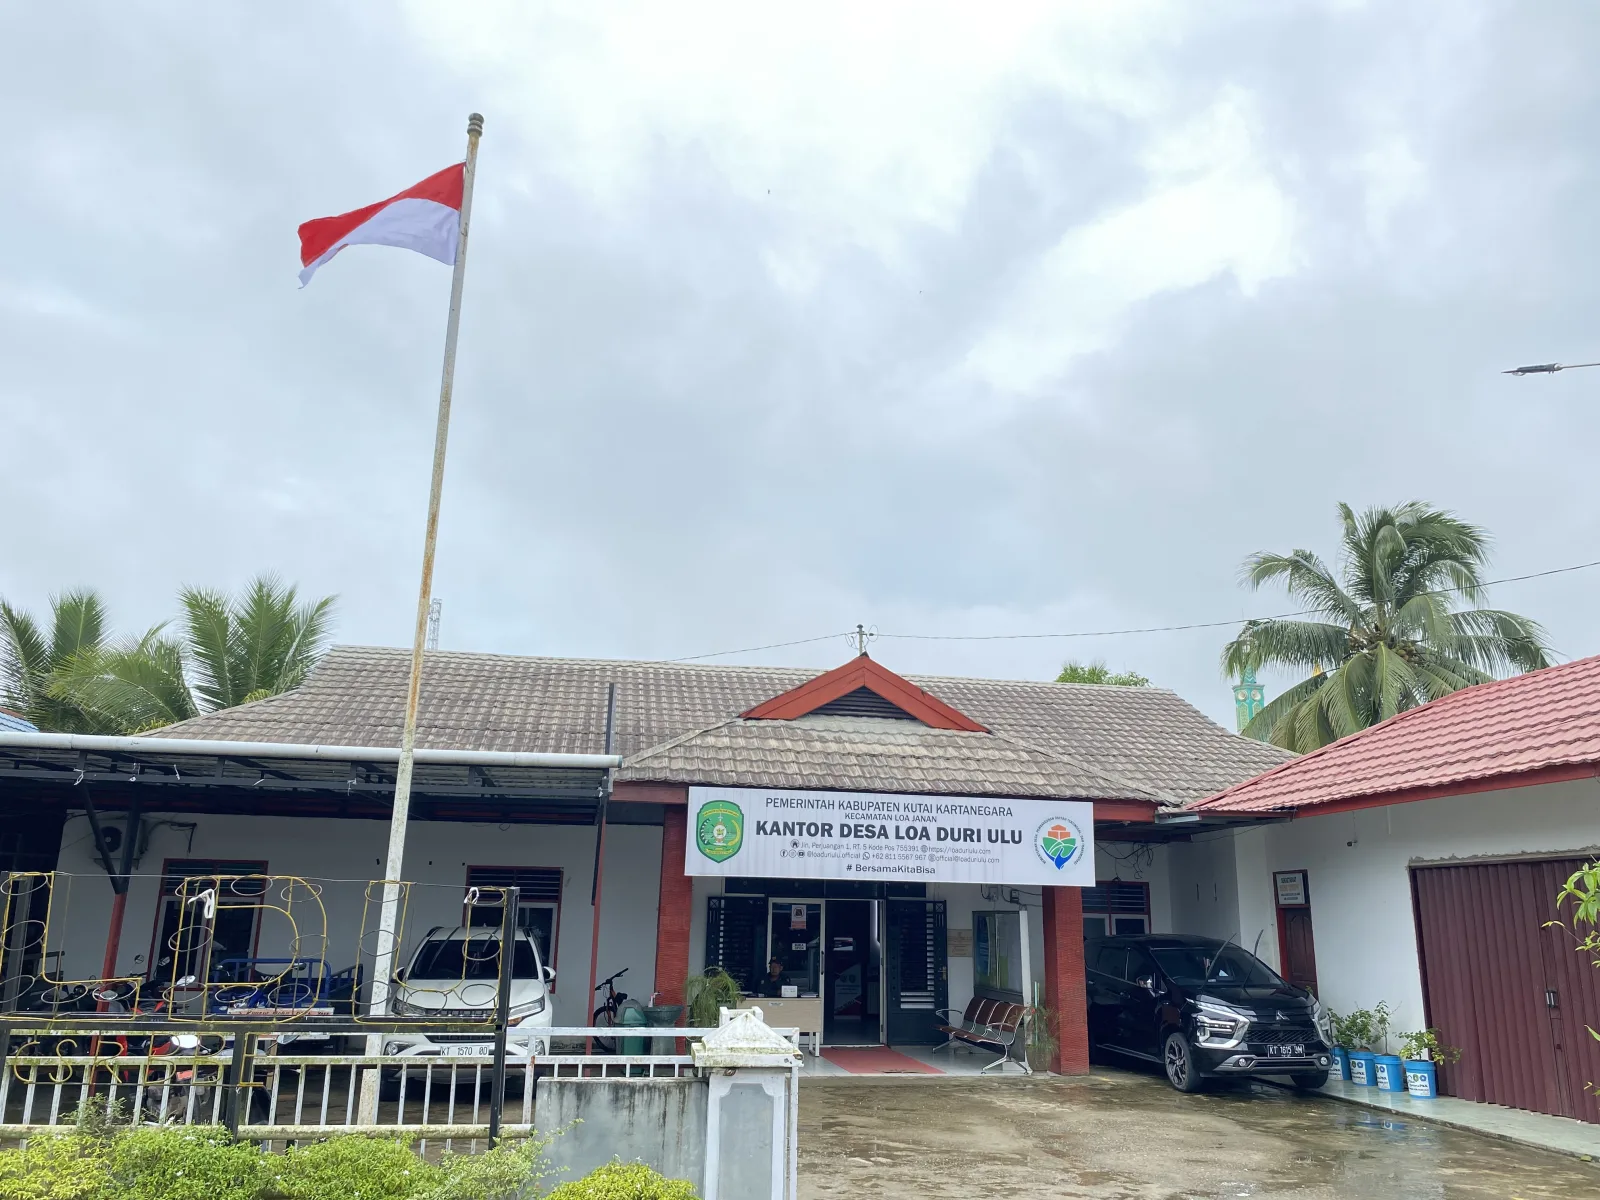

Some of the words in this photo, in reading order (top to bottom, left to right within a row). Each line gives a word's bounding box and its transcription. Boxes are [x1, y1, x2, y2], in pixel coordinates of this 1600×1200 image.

[765, 797, 835, 810] PEMERINTAH
[838, 799, 900, 812] KABUPATEN
[903, 802, 933, 814] KUTAI
[936, 804, 1013, 817] KARTANEGARA
[844, 812, 893, 821] KECAMATAN
[894, 814, 910, 822] LOA
[911, 815, 938, 823] JANAN
[756, 820, 834, 838] KANTOR
[839, 823, 889, 840] DESA
[894, 825, 931, 841] LOA
[936, 826, 982, 843] DURI
[987, 828, 1023, 845] ULU
[811, 842, 844, 851] Perjuangan
[872, 852, 883, 860] +62
[855, 863, 936, 874] BersamaKitaBisa
[457, 1046, 473, 1056] 1570
